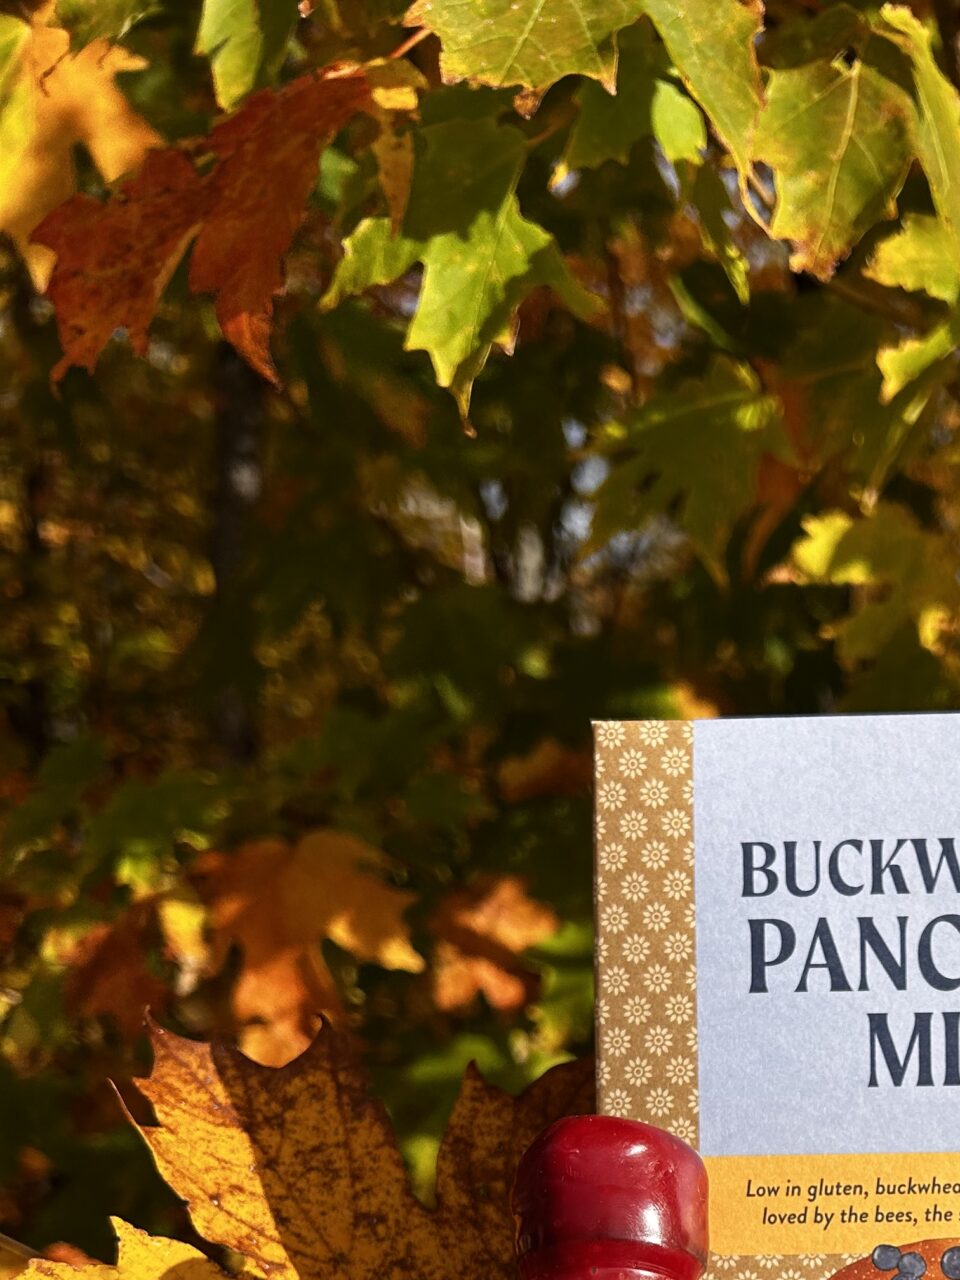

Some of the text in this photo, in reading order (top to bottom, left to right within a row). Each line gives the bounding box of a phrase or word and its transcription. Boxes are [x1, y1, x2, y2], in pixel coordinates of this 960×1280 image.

[746, 1179, 780, 1198] Low
[785, 1179, 802, 1197] in
[807, 1178, 869, 1202] gluten,
[762, 1207, 808, 1225] loved
[813, 1207, 835, 1231] by
[839, 1205, 869, 1224] the
[874, 1204, 918, 1226] bees,
[924, 1204, 953, 1222] the
